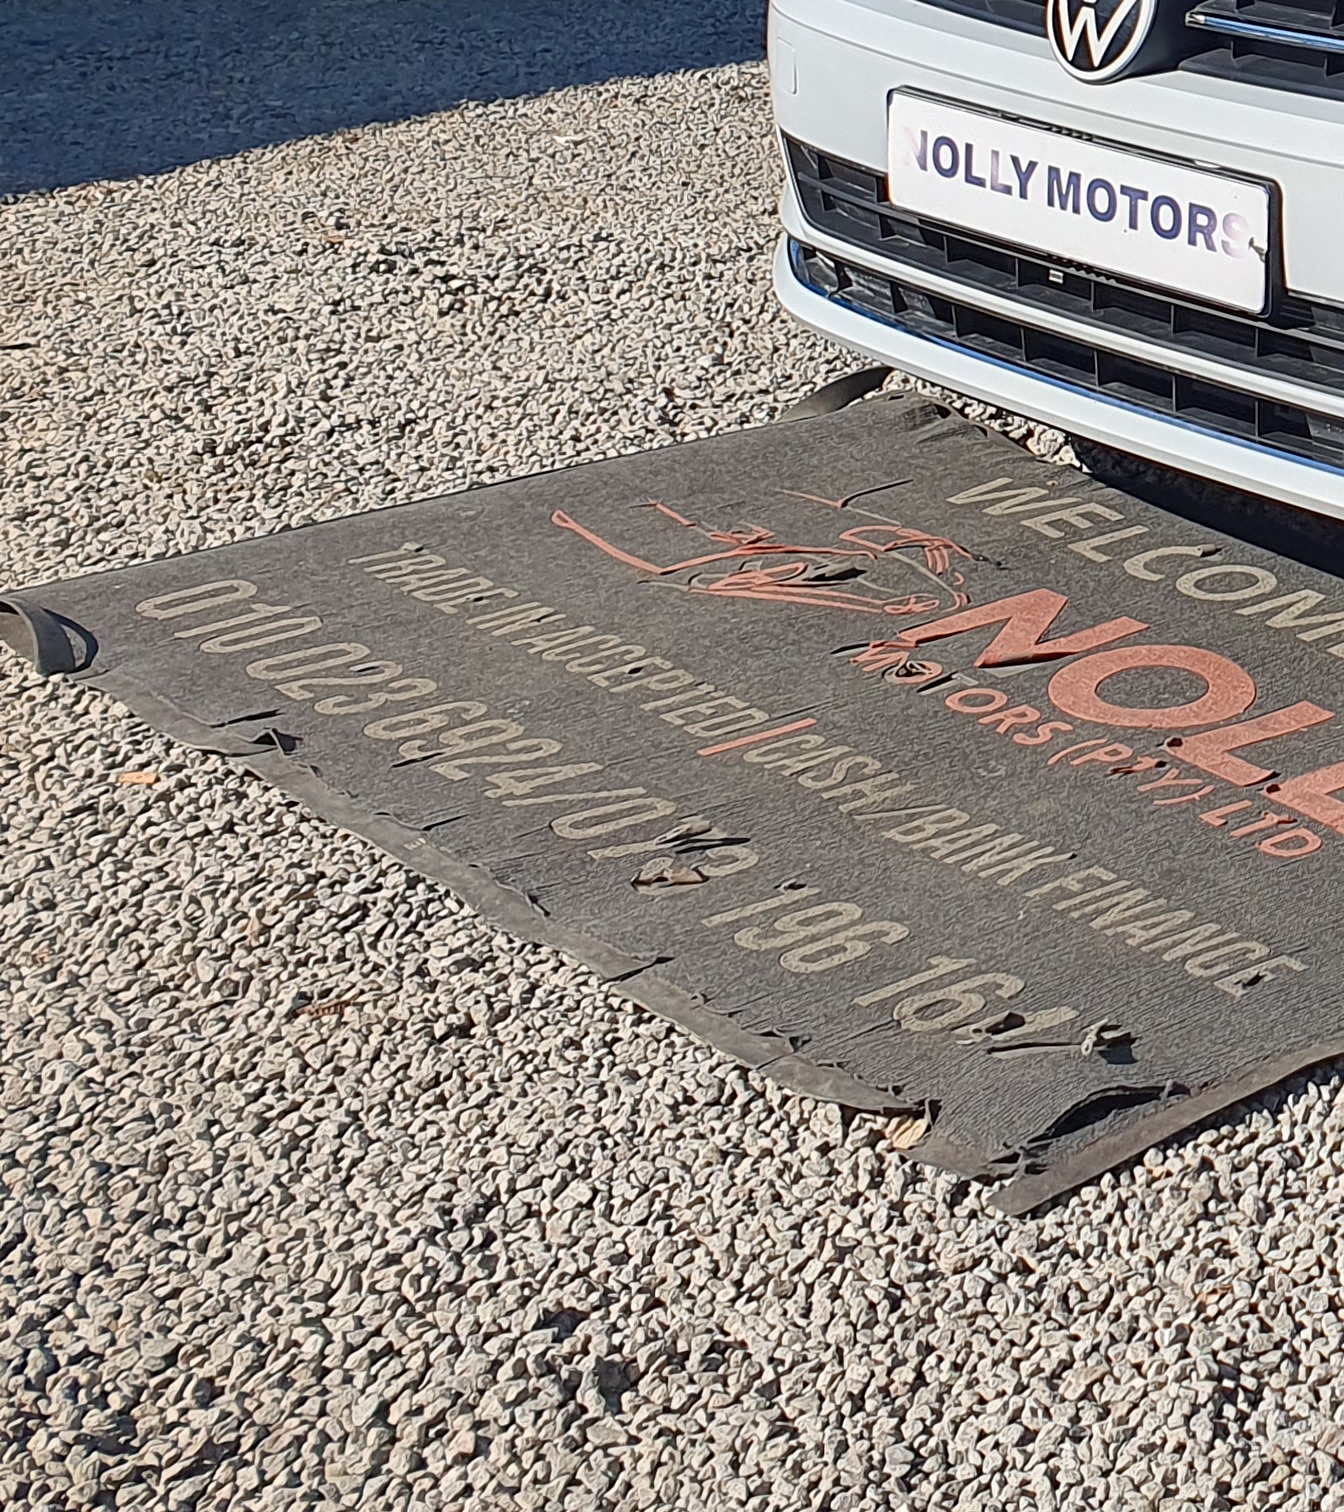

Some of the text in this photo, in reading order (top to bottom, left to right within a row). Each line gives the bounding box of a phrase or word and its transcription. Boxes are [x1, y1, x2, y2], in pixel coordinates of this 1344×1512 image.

[1047, 165, 1250, 259] MOTORS
[348, 542, 519, 614] TRADE
[466, 601, 567, 637] IN
[511, 625, 770, 738] ACCEPTED
[835, 640, 1323, 857] MOTORS (PTY) LTD
[700, 887, 910, 974] 196
[1025, 866, 1307, 998] FINANCE
